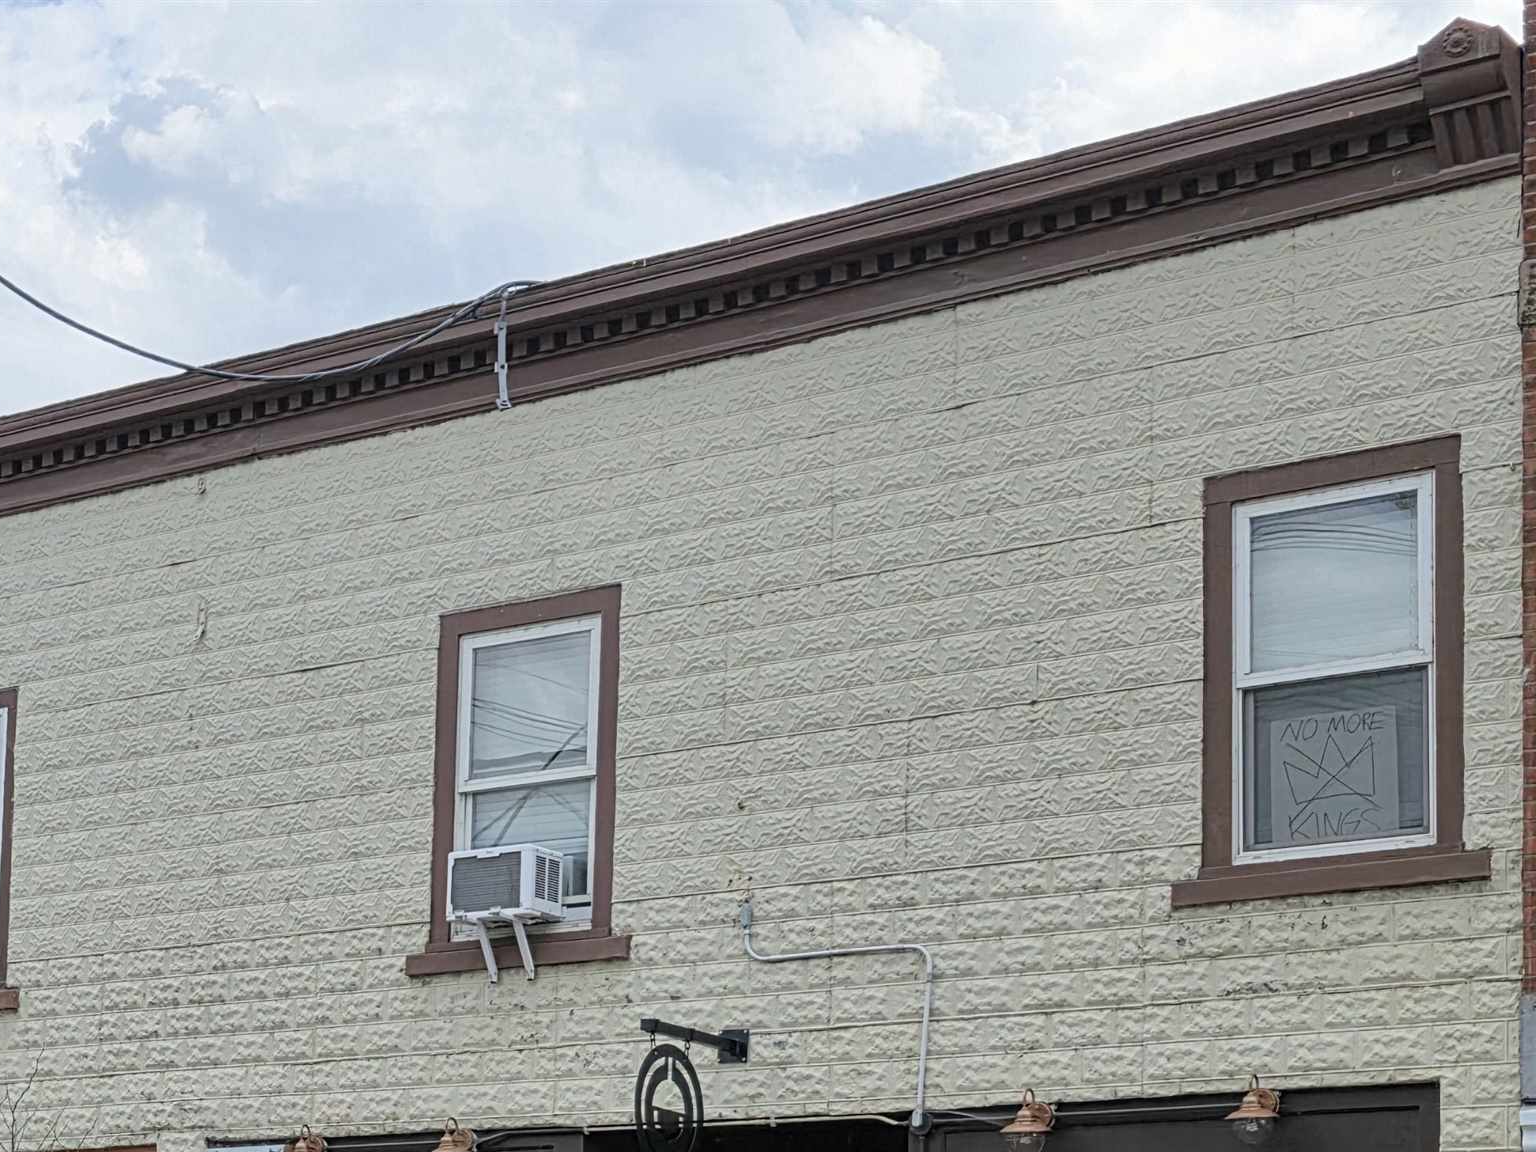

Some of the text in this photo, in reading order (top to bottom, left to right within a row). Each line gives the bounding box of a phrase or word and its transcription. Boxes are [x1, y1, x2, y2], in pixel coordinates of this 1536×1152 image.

[1280, 711, 1385, 741] NO MORE
[1287, 808, 1382, 841] KINGS
